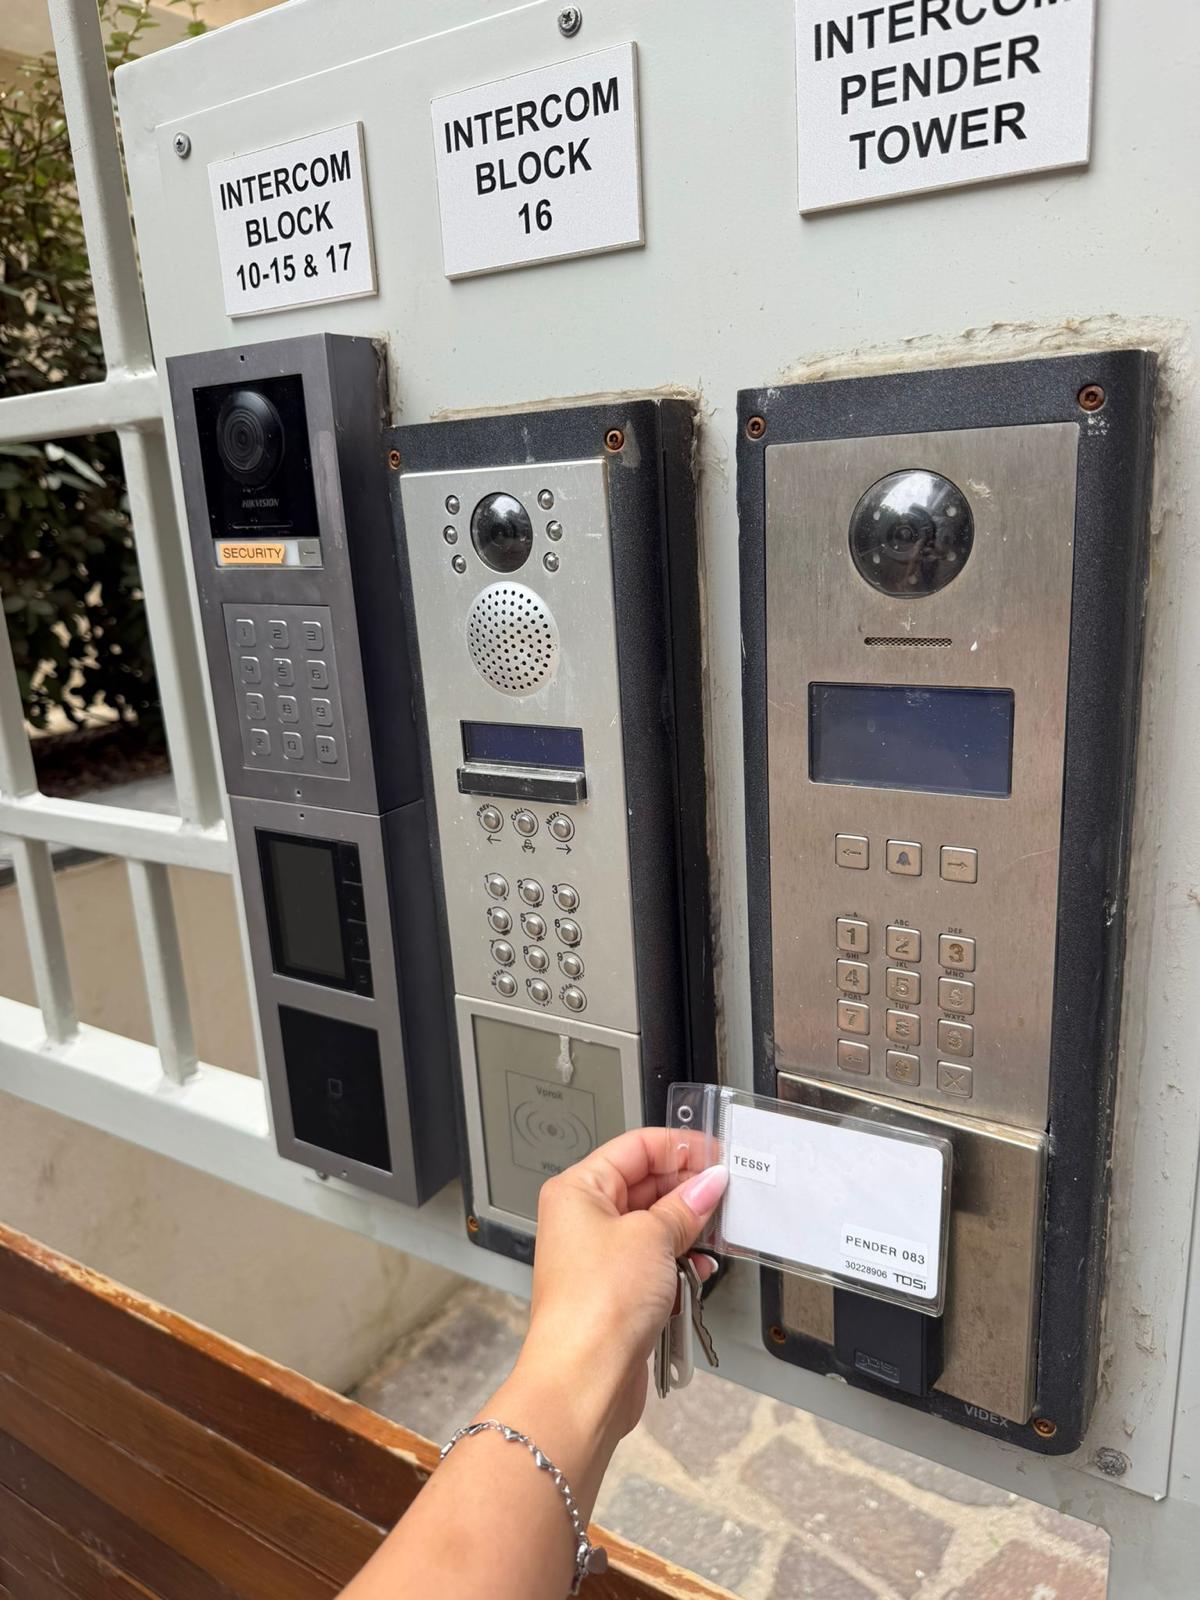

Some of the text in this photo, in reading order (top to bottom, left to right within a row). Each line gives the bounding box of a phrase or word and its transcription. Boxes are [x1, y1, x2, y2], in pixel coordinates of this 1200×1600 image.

[813, 0, 1071, 62] INTERC
[840, 34, 1041, 115] PENDER
[444, 76, 620, 153] INTERCOM
[849, 101, 1027, 170] TOWER
[475, 137, 593, 195] BLOCK
[219, 150, 351, 210] INTERCOM
[245, 201, 334, 247] BLOCK
[518, 199, 552, 234] 16
[236, 242, 352, 290] 10-15 & 17
[241, 497, 280, 509] HIKVISION
[223, 547, 282, 559] SECURITY
[476, 803, 560, 826] PREV CALL NEXT
[516, 879, 524, 890] 2
[551, 884, 559, 895] 3
[486, 908, 493, 917] 4
[519, 913, 527, 923] 5
[489, 939, 563, 962] 7 8 9
[846, 928, 965, 963] 1 2 3
[845, 968, 859, 986] 4
[895, 977, 909, 997] 5
[945, 970, 965, 978] MNO
[525, 978, 532, 988] 0
[558, 983, 574, 1000] CLEAR
[846, 1007, 860, 1026] 7
[733, 1155, 771, 1173] TESSY
[845, 1234, 925, 1265] PENDER 083
[844, 1260, 888, 1279] 30228906
[963, 1403, 1009, 1428] VIDEX
